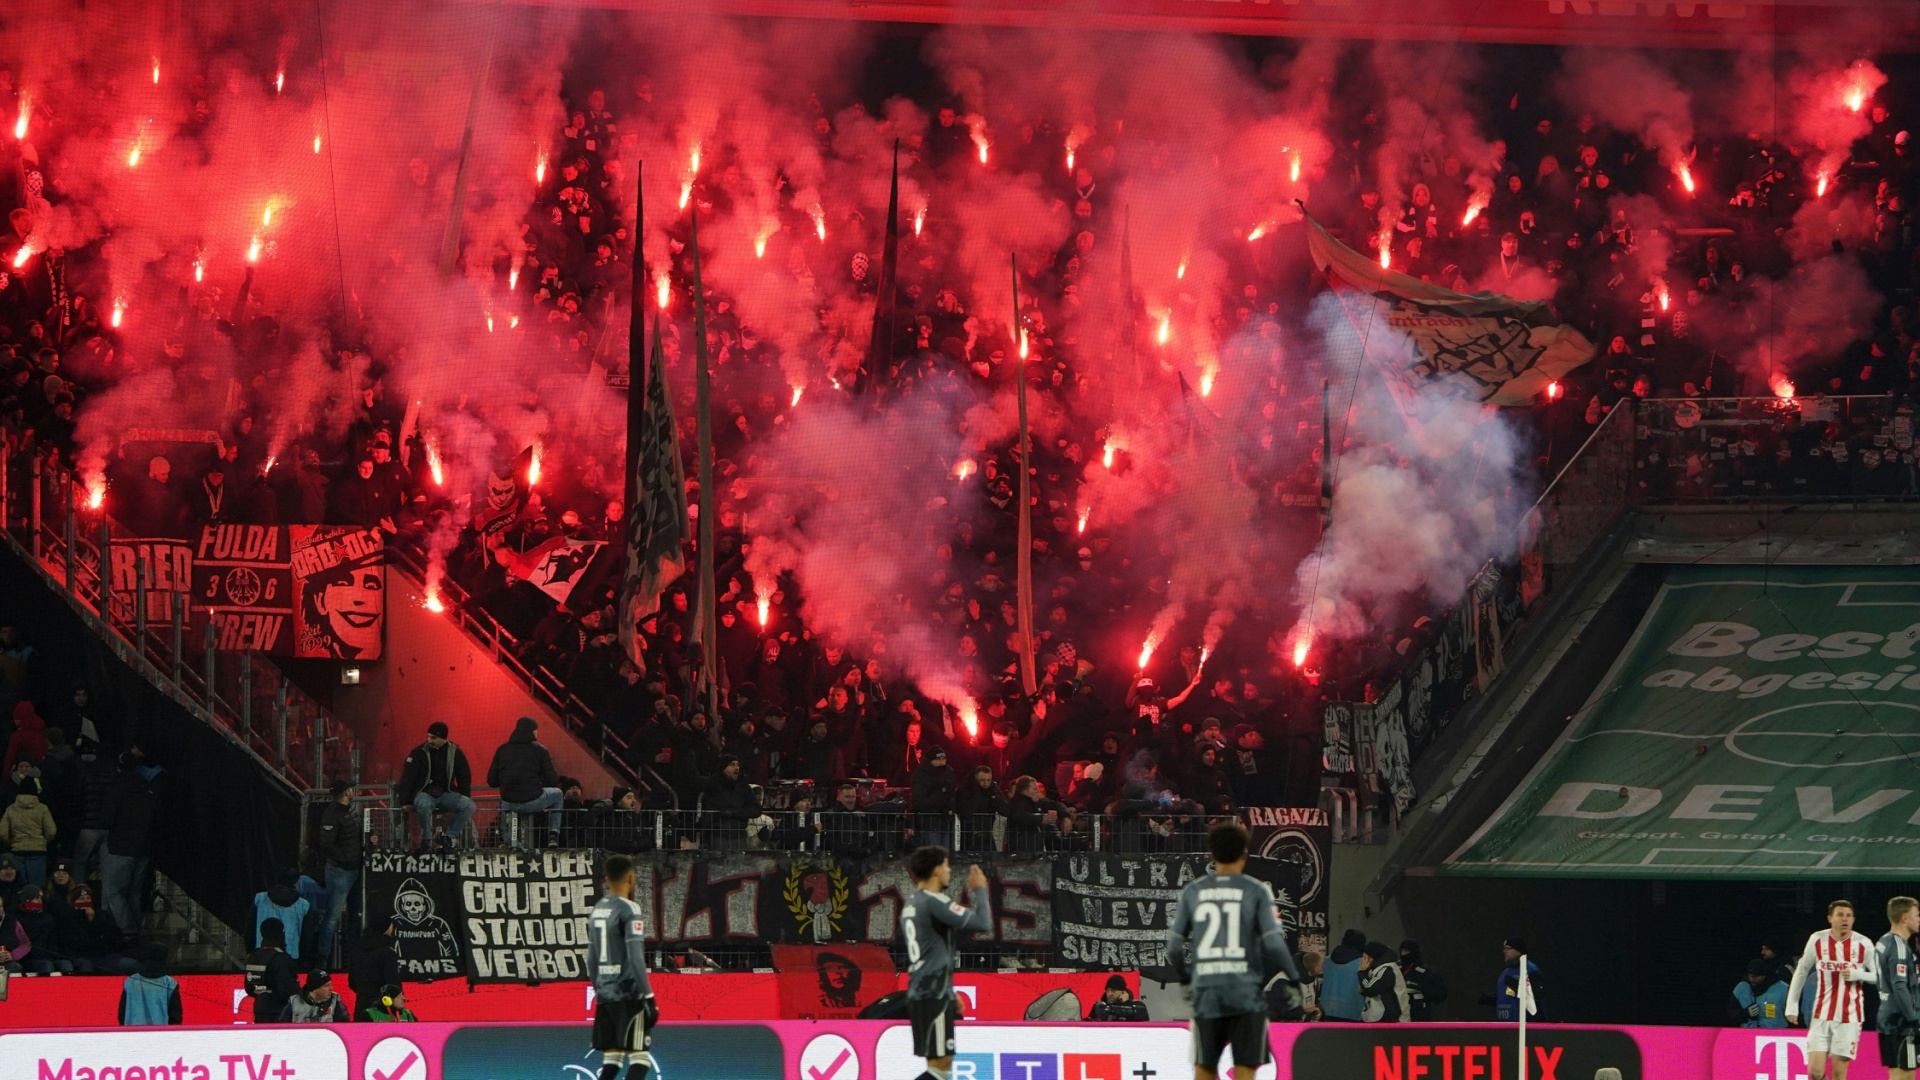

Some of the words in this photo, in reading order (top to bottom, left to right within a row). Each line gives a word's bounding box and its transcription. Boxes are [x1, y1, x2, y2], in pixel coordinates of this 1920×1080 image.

[198, 525, 278, 560] FULDA
[206, 575, 219, 597] 3
[265, 578, 277, 600] 6
[204, 614, 283, 650] CREW
[300, 635, 331, 653] 1999
[1249, 807, 1329, 827] RAGAZZI
[1537, 783, 1920, 825] DEV
[1700, 832, 1792, 841] Getan.
[372, 854, 455, 873] EXTREME
[460, 855, 524, 878] EHRE
[543, 853, 593, 878] DER
[463, 879, 594, 915] GRUPPE
[594, 919, 608, 962] 1
[905, 918, 921, 963] 8
[1194, 902, 1246, 959] 21
[219, 1055, 294, 1080] TV+
